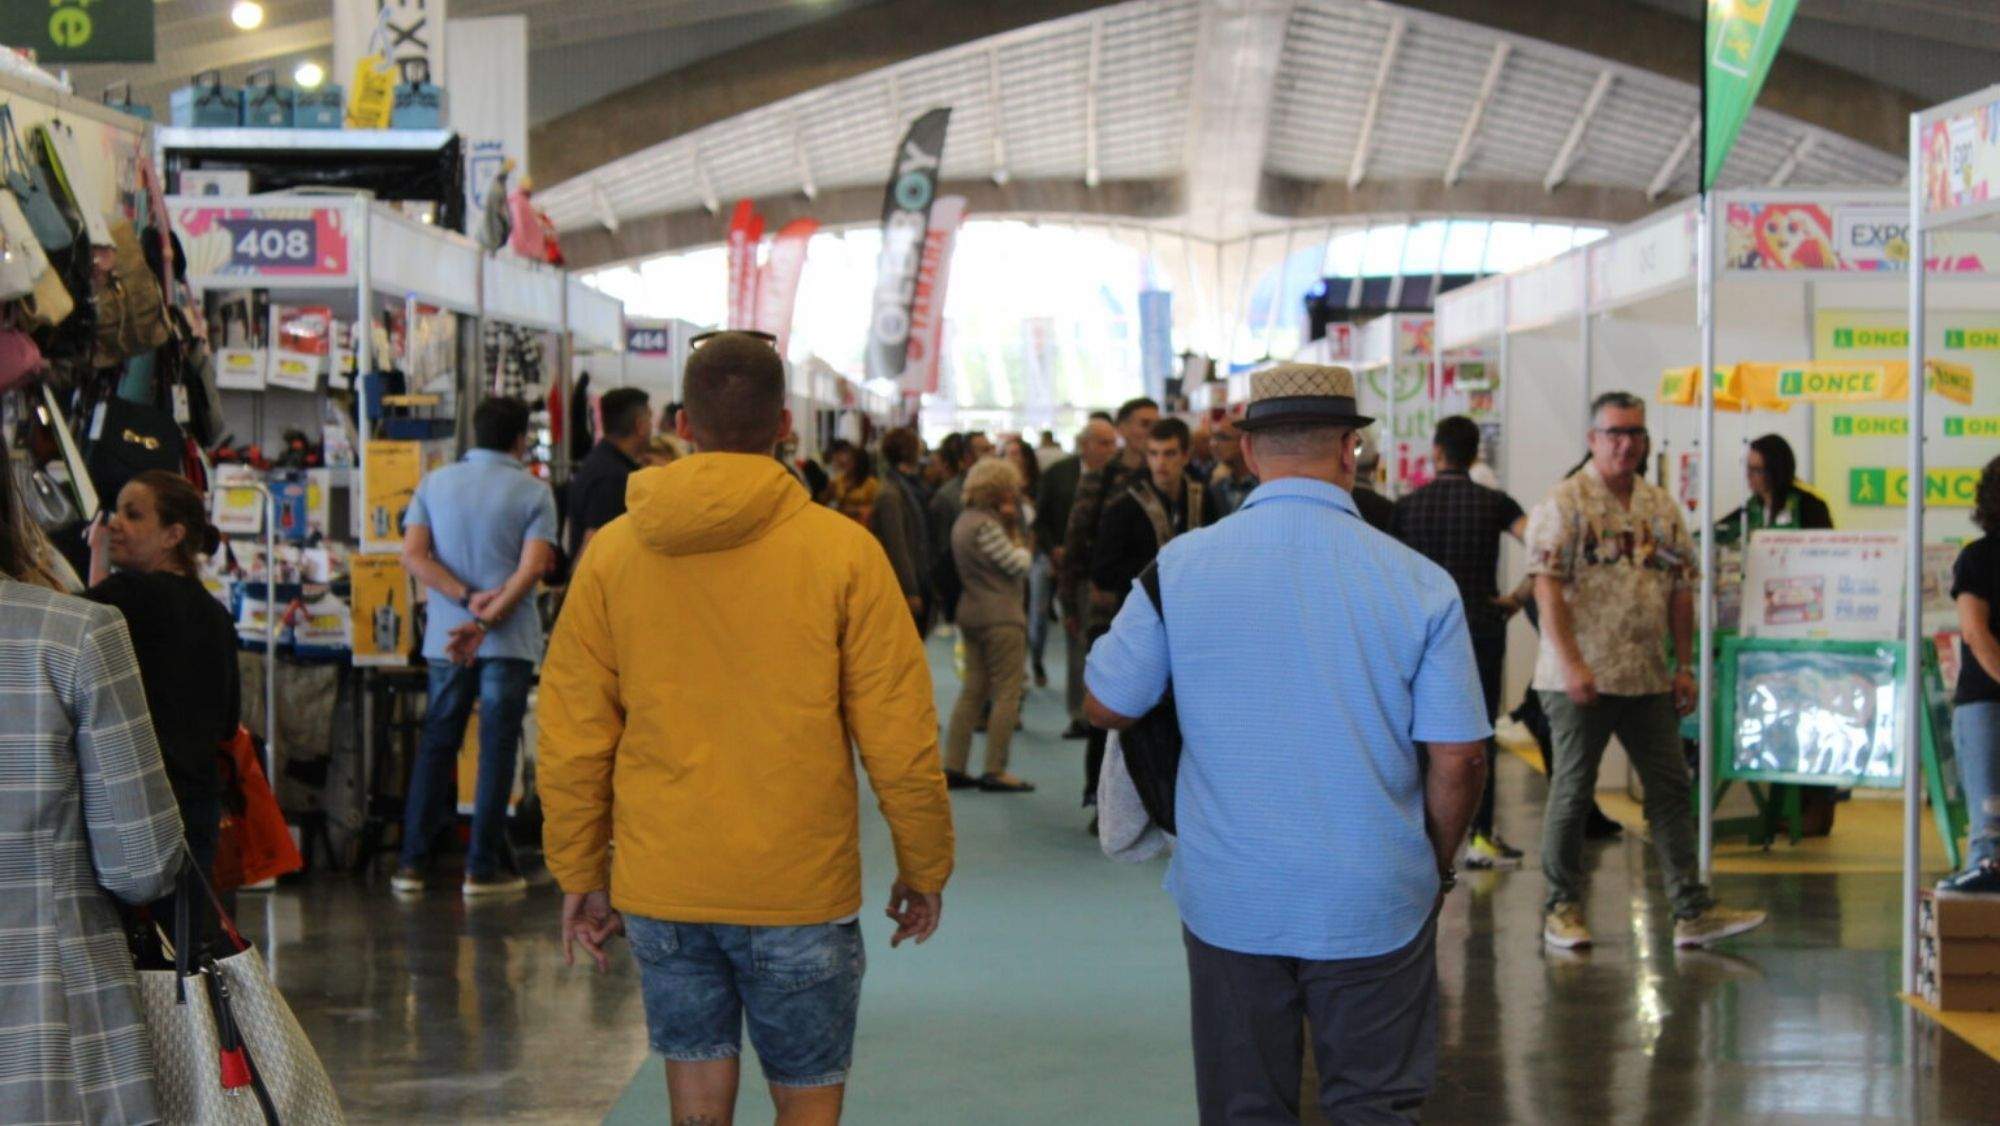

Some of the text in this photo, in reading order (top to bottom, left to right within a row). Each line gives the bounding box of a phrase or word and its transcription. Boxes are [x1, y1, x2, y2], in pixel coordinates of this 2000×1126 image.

[236, 229, 309, 259] 408
[630, 332, 664, 349] 414
[1808, 373, 1876, 392] ONCE
